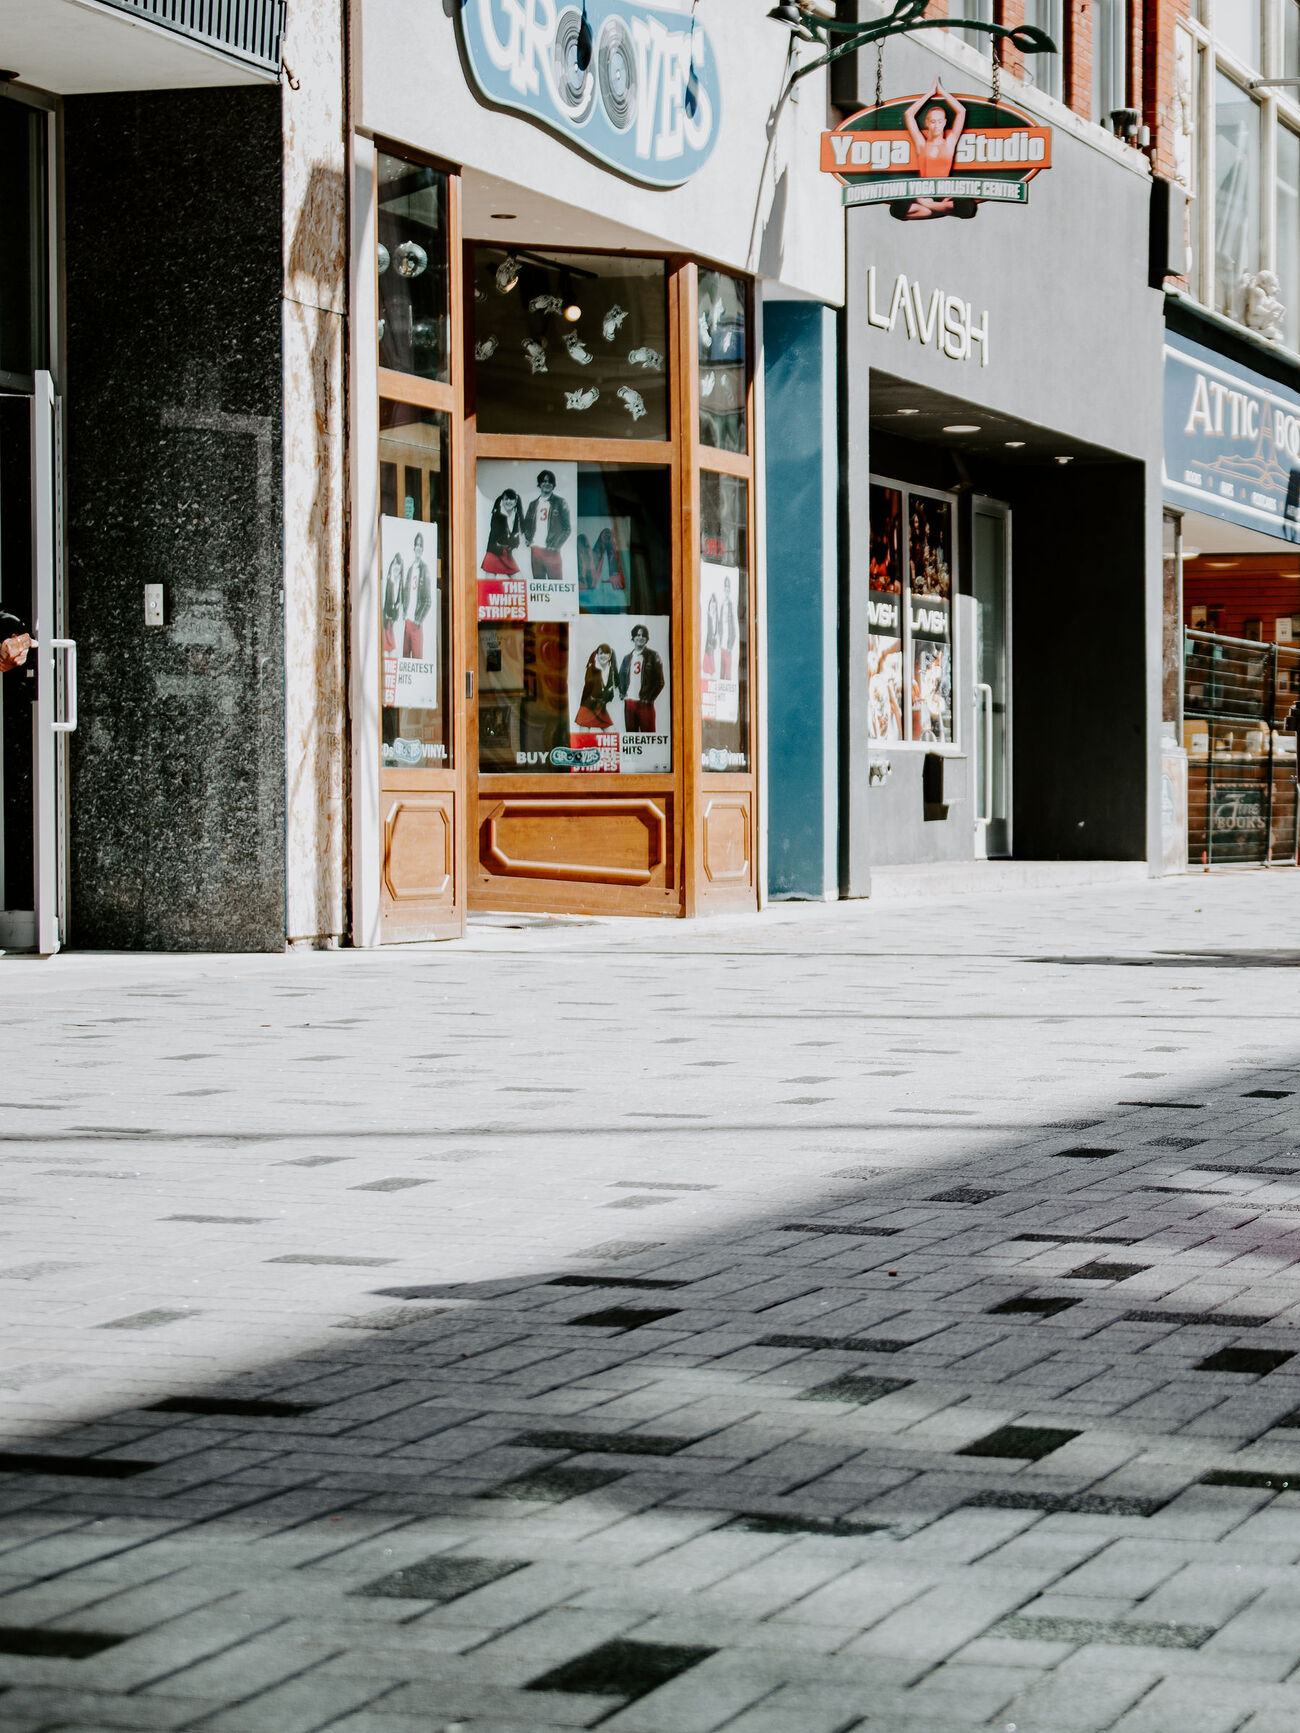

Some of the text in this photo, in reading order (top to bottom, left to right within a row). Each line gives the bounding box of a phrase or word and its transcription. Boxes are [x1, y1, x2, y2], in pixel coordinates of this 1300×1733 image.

[478, 0, 713, 160] GROOVES
[829, 132, 1046, 169] Yoga Studio
[846, 180, 1021, 202] DOWNTOWN YOGA HOLISTIC CENTRE
[867, 266, 989, 368] LAVISH
[1184, 374, 1260, 441] ATTIC
[540, 508, 548, 521] 3
[503, 581, 525, 593] THE
[529, 583, 576, 593] GREATEST
[488, 593, 526, 606] WHITE
[530, 593, 551, 602] HITS
[478, 605, 526, 618] STRIPES
[910, 607, 948, 635] LAVISH
[398, 662, 434, 674] GREATEST
[633, 661, 641, 674] 3
[398, 674, 412, 685] HITS
[595, 735, 618, 746] THE
[622, 735, 669, 745] GREATEST
[421, 743, 447, 758] VINYL
[516, 751, 549, 764] BUY
[552, 748, 599, 765] GROOVES
[622, 746, 643, 755] HITS
[1215, 815, 1267, 830] BOOKS
